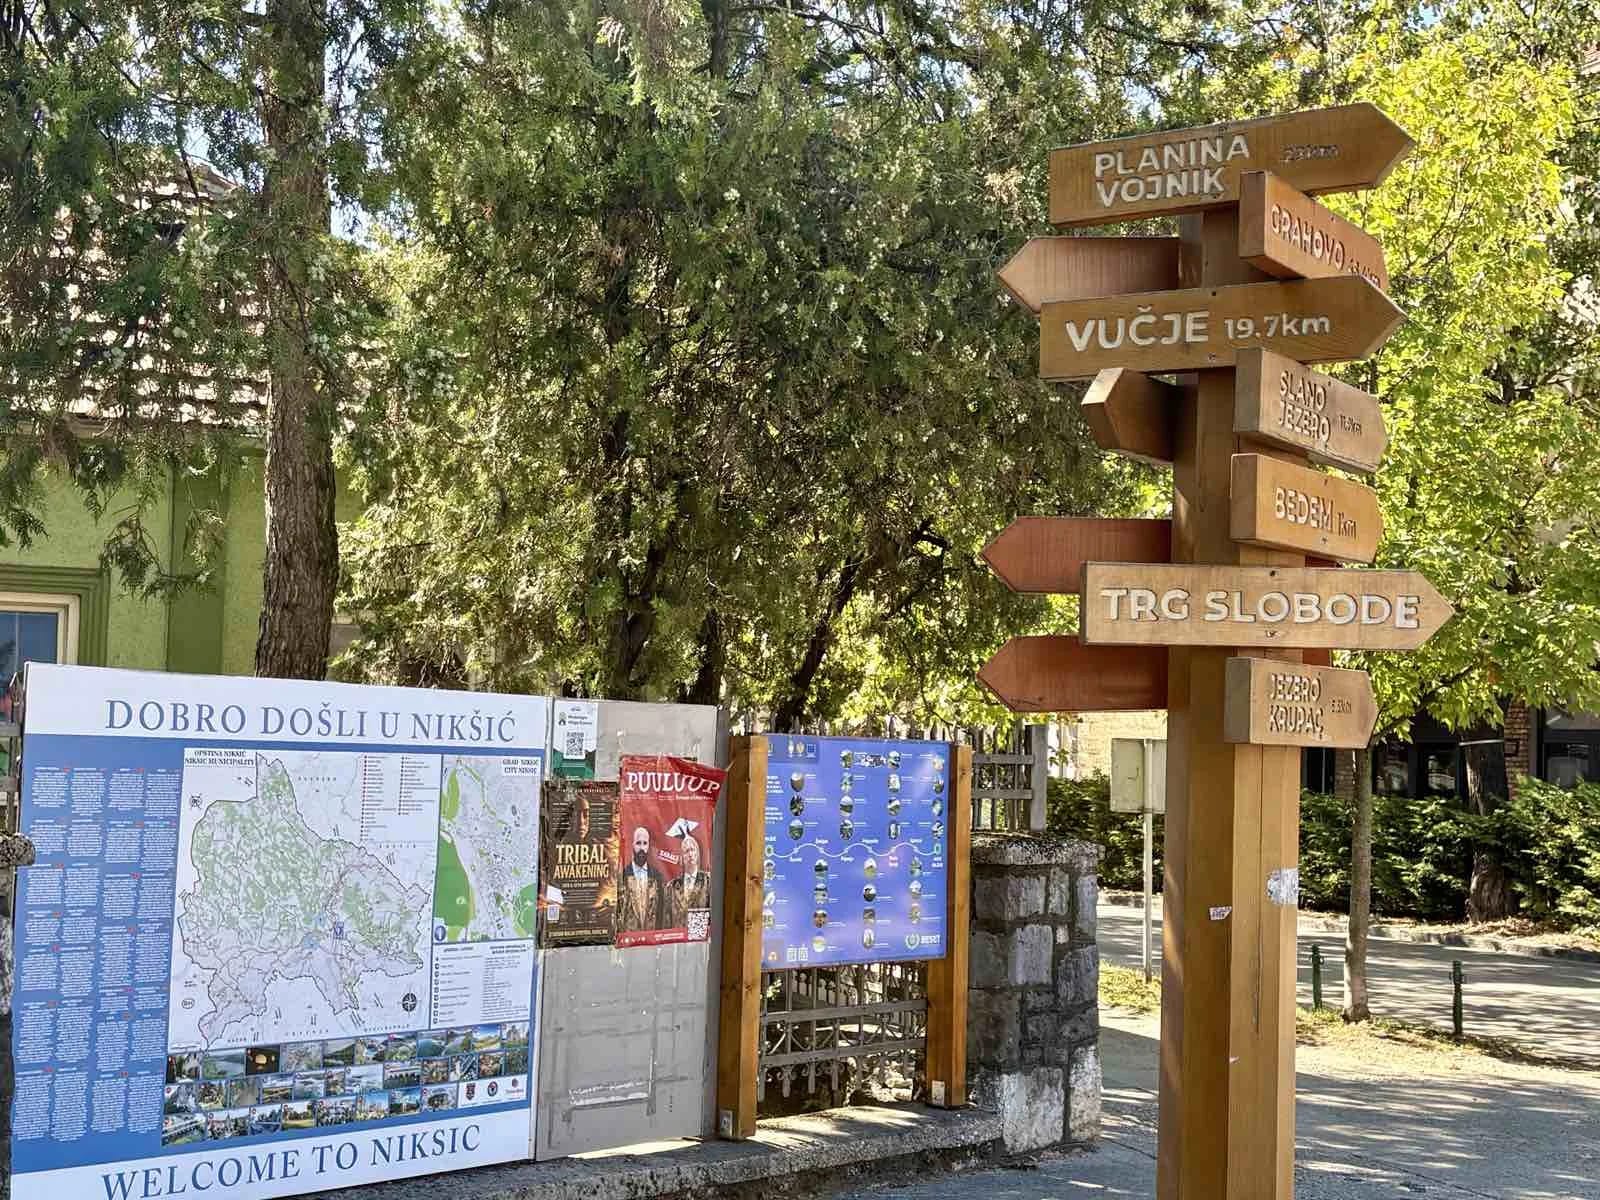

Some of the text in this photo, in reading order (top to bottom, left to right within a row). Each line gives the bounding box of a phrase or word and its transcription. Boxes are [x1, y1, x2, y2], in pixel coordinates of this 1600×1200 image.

[1095, 135, 1250, 177] PLANINA
[1096, 167, 1225, 207] VOJNIK
[1271, 203, 1345, 271] GRAHOVO
[1065, 306, 1330, 351] VUČJE 19.7km
[1280, 370, 1327, 412] SLANO
[1279, 399, 1331, 441] JEZERO
[1275, 487, 1334, 532] BEDEM
[1101, 588, 1420, 629] TRG SLOBODE
[1270, 673, 1322, 702] JEZERO
[105, 699, 516, 742] DOBRO DOŠLI U NIKŠIĆ
[1269, 705, 1324, 734] KRUPAC
[625, 771, 720, 794] PUULUUP
[553, 864, 609, 879] AWAKENING
[556, 844, 608, 864] TRIBAL
[102, 1124, 481, 1200] WELCOME TO NIKSIC
